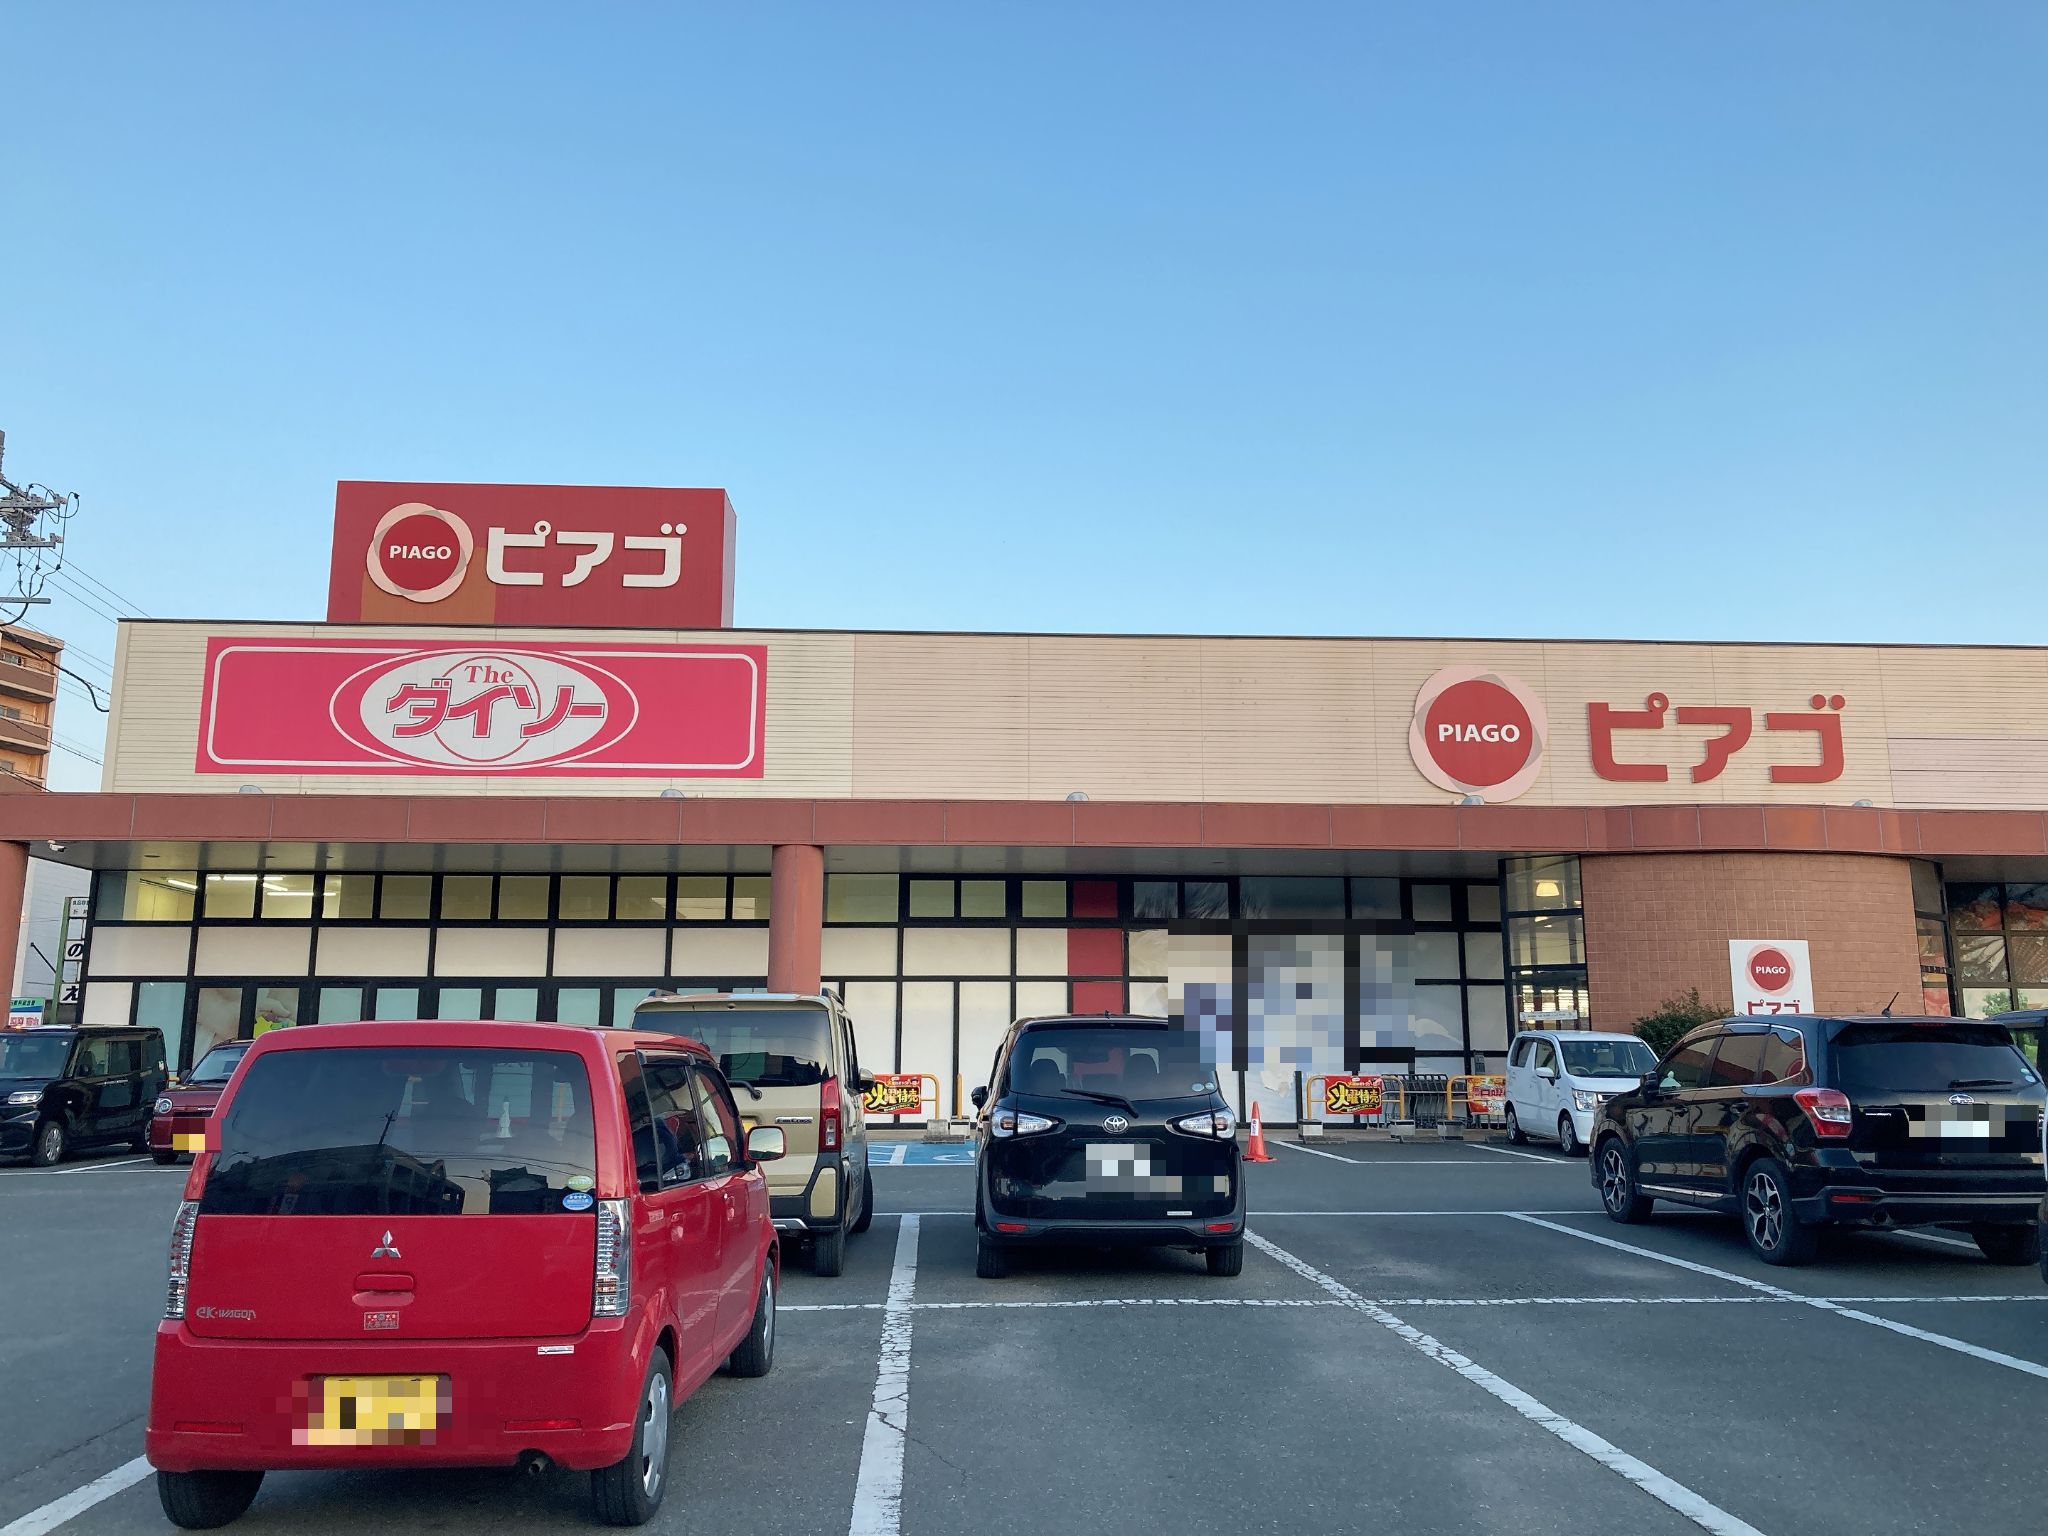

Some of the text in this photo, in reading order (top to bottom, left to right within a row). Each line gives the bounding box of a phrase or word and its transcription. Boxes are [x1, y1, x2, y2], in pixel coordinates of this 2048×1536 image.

[389, 545, 452, 560] PIAGO
[486, 520, 688, 588] ピアゴ
[464, 665, 514, 683] The
[386, 678, 605, 738] ダイソー
[1438, 723, 1521, 743] PIAGO
[1587, 692, 1846, 784] ピアゴ
[1755, 966, 1786, 974] PIAGO
